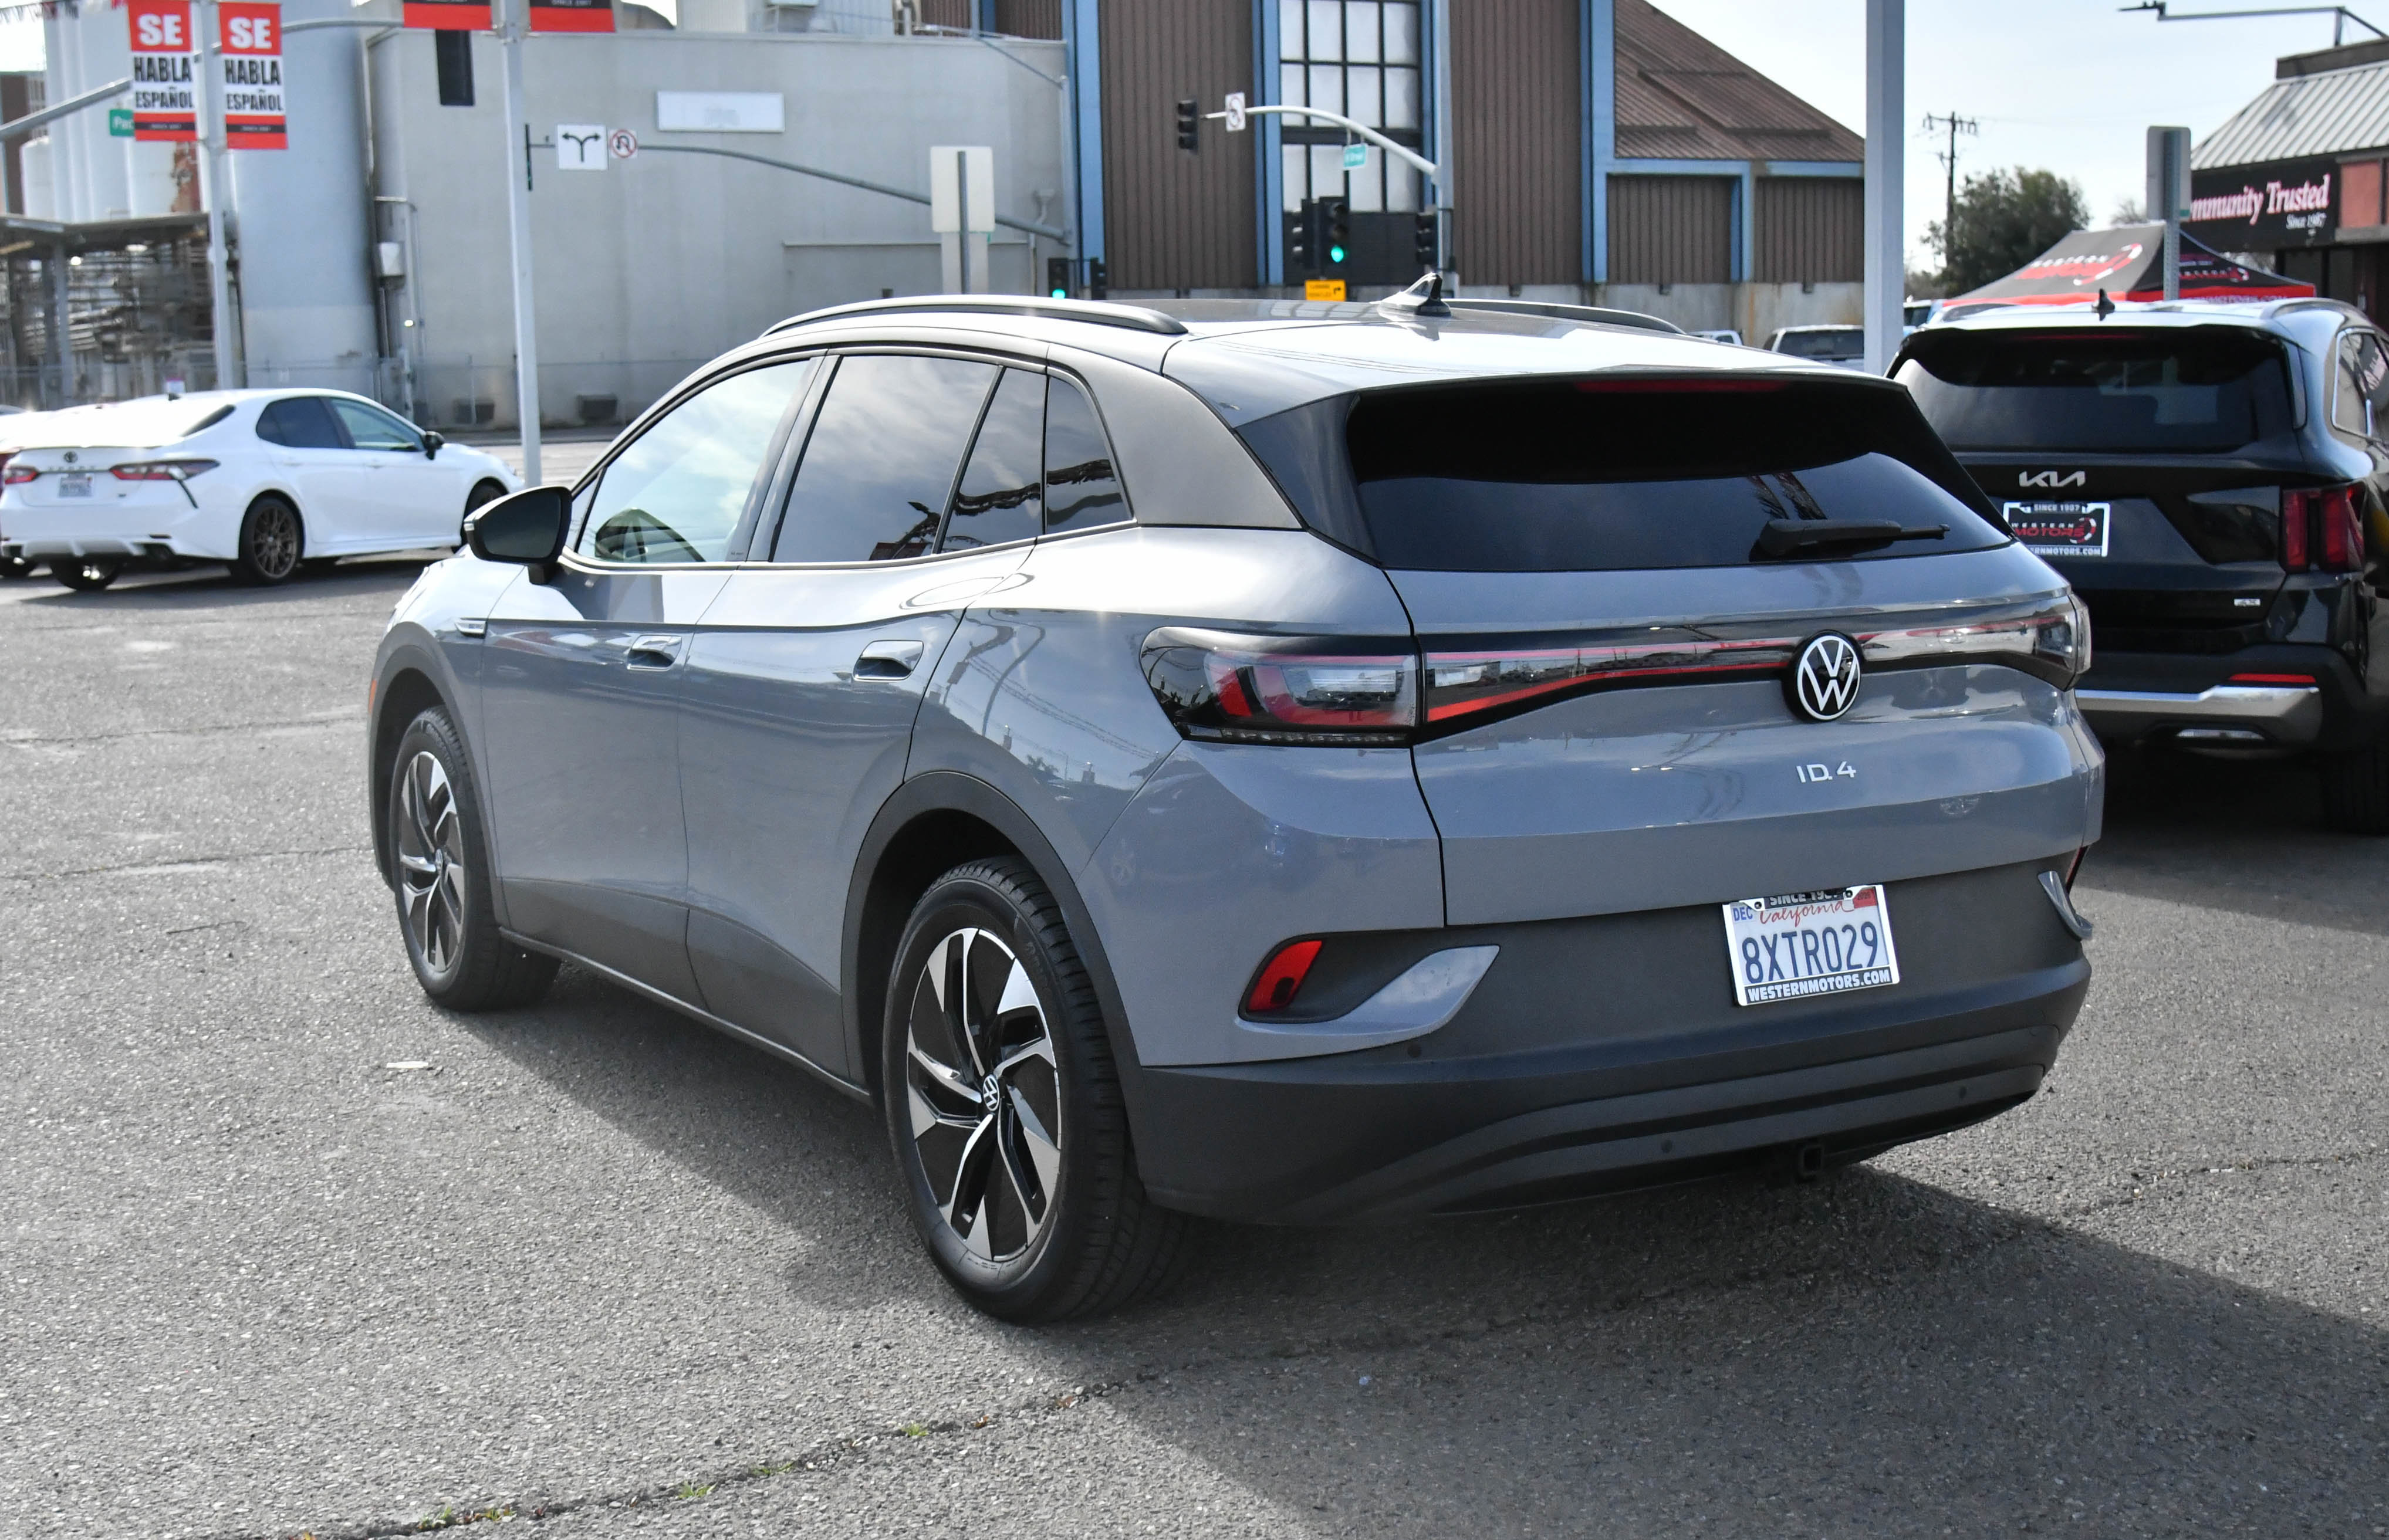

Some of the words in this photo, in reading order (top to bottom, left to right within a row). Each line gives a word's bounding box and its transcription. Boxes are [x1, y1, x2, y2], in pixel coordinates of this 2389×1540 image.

[137, 13, 184, 46] SE
[229, 16, 273, 49] SE
[134, 56, 192, 83] HABLA
[225, 59, 281, 85] HABLA
[136, 86, 194, 108] ESPAÑOL
[227, 89, 283, 111] ESPAÑOL
[2190, 185, 2263, 225] mmunity
[2266, 173, 2330, 214] Trusted
[2019, 471, 2085, 487] KIA
[2033, 503, 2057, 512] SINCE
[1733, 907, 1753, 922] DEC
[1742, 921, 1878, 984] 8XTR029
[1748, 969, 1890, 1001] WESTERNMOTORS.COM
